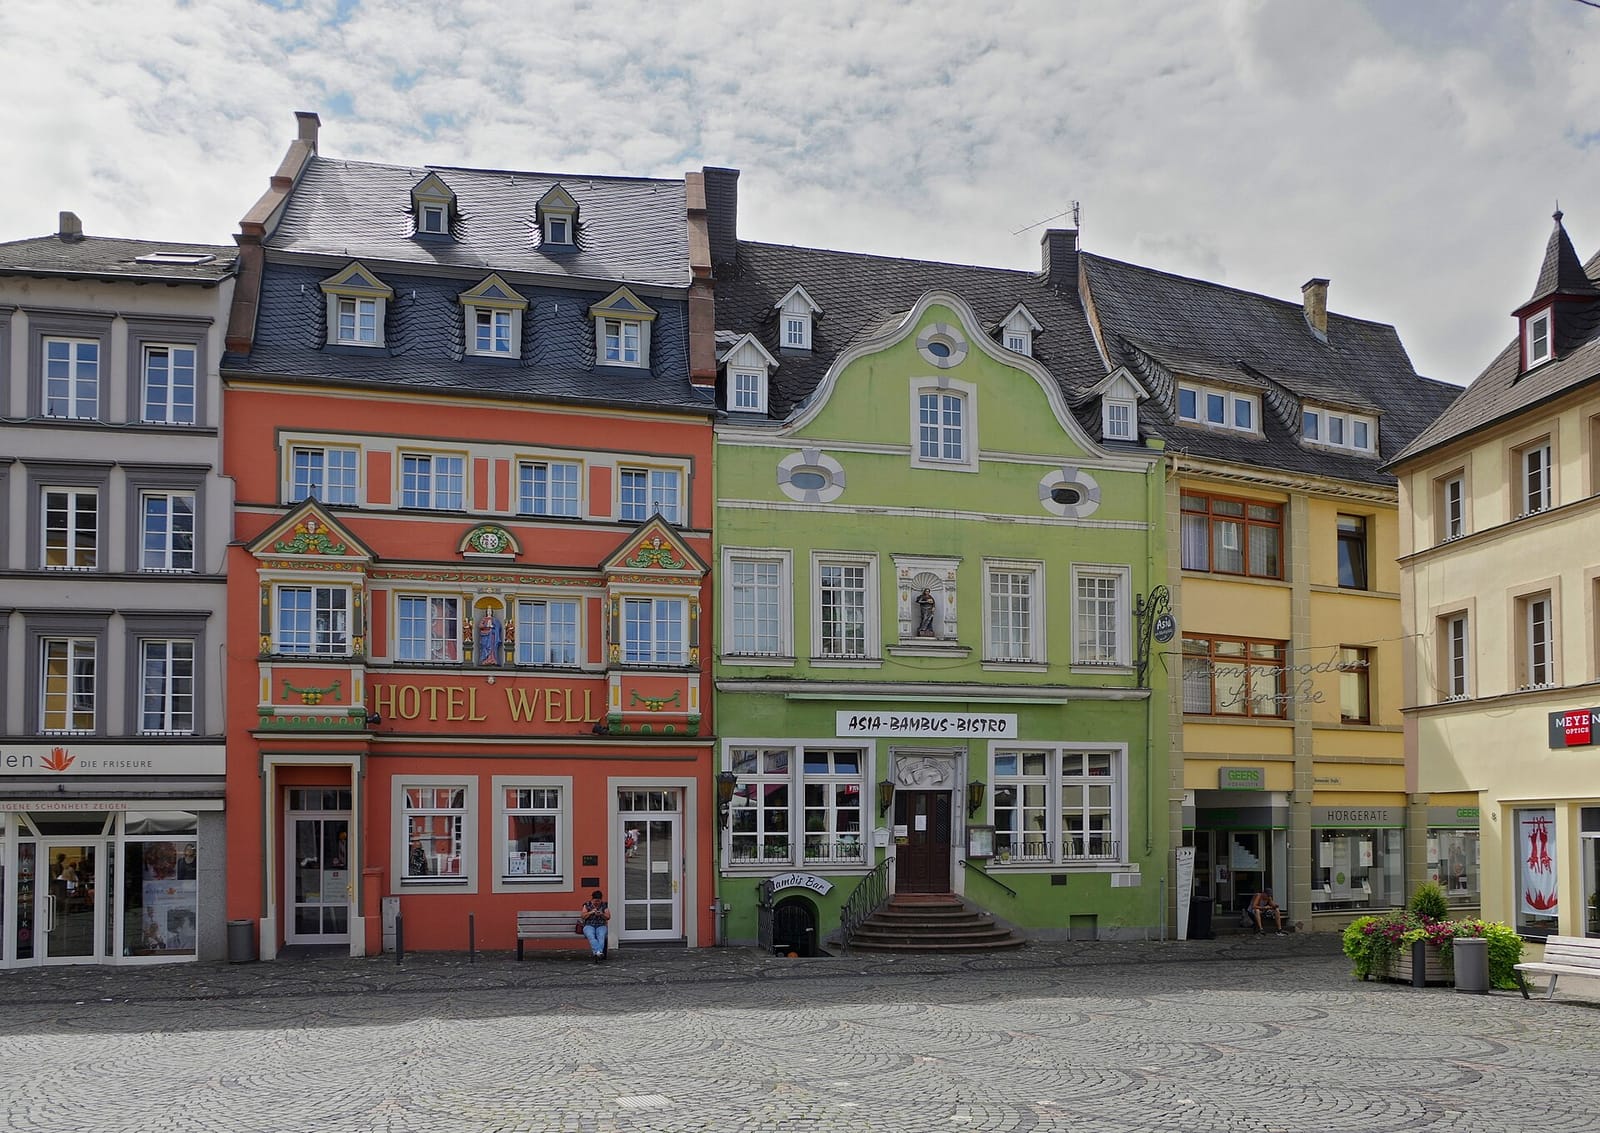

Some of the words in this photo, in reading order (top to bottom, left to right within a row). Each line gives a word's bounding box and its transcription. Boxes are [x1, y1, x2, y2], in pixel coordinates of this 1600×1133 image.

[374, 684, 487, 721] HOTEL
[505, 688, 600, 723] WELL
[849, 716, 1007, 732] ASIA-BAMBUS-BISTRO
[80, 760, 97, 768] DIE
[103, 760, 152, 768] FRISEURE
[1228, 770, 1259, 781] GEERS
[35, 802, 88, 810] SCHÖNHEIT
[94, 802, 127, 810] ZEIGEN
[1328, 809, 1388, 822] HÖRGERÄTE
[805, 876, 825, 891] Bar
